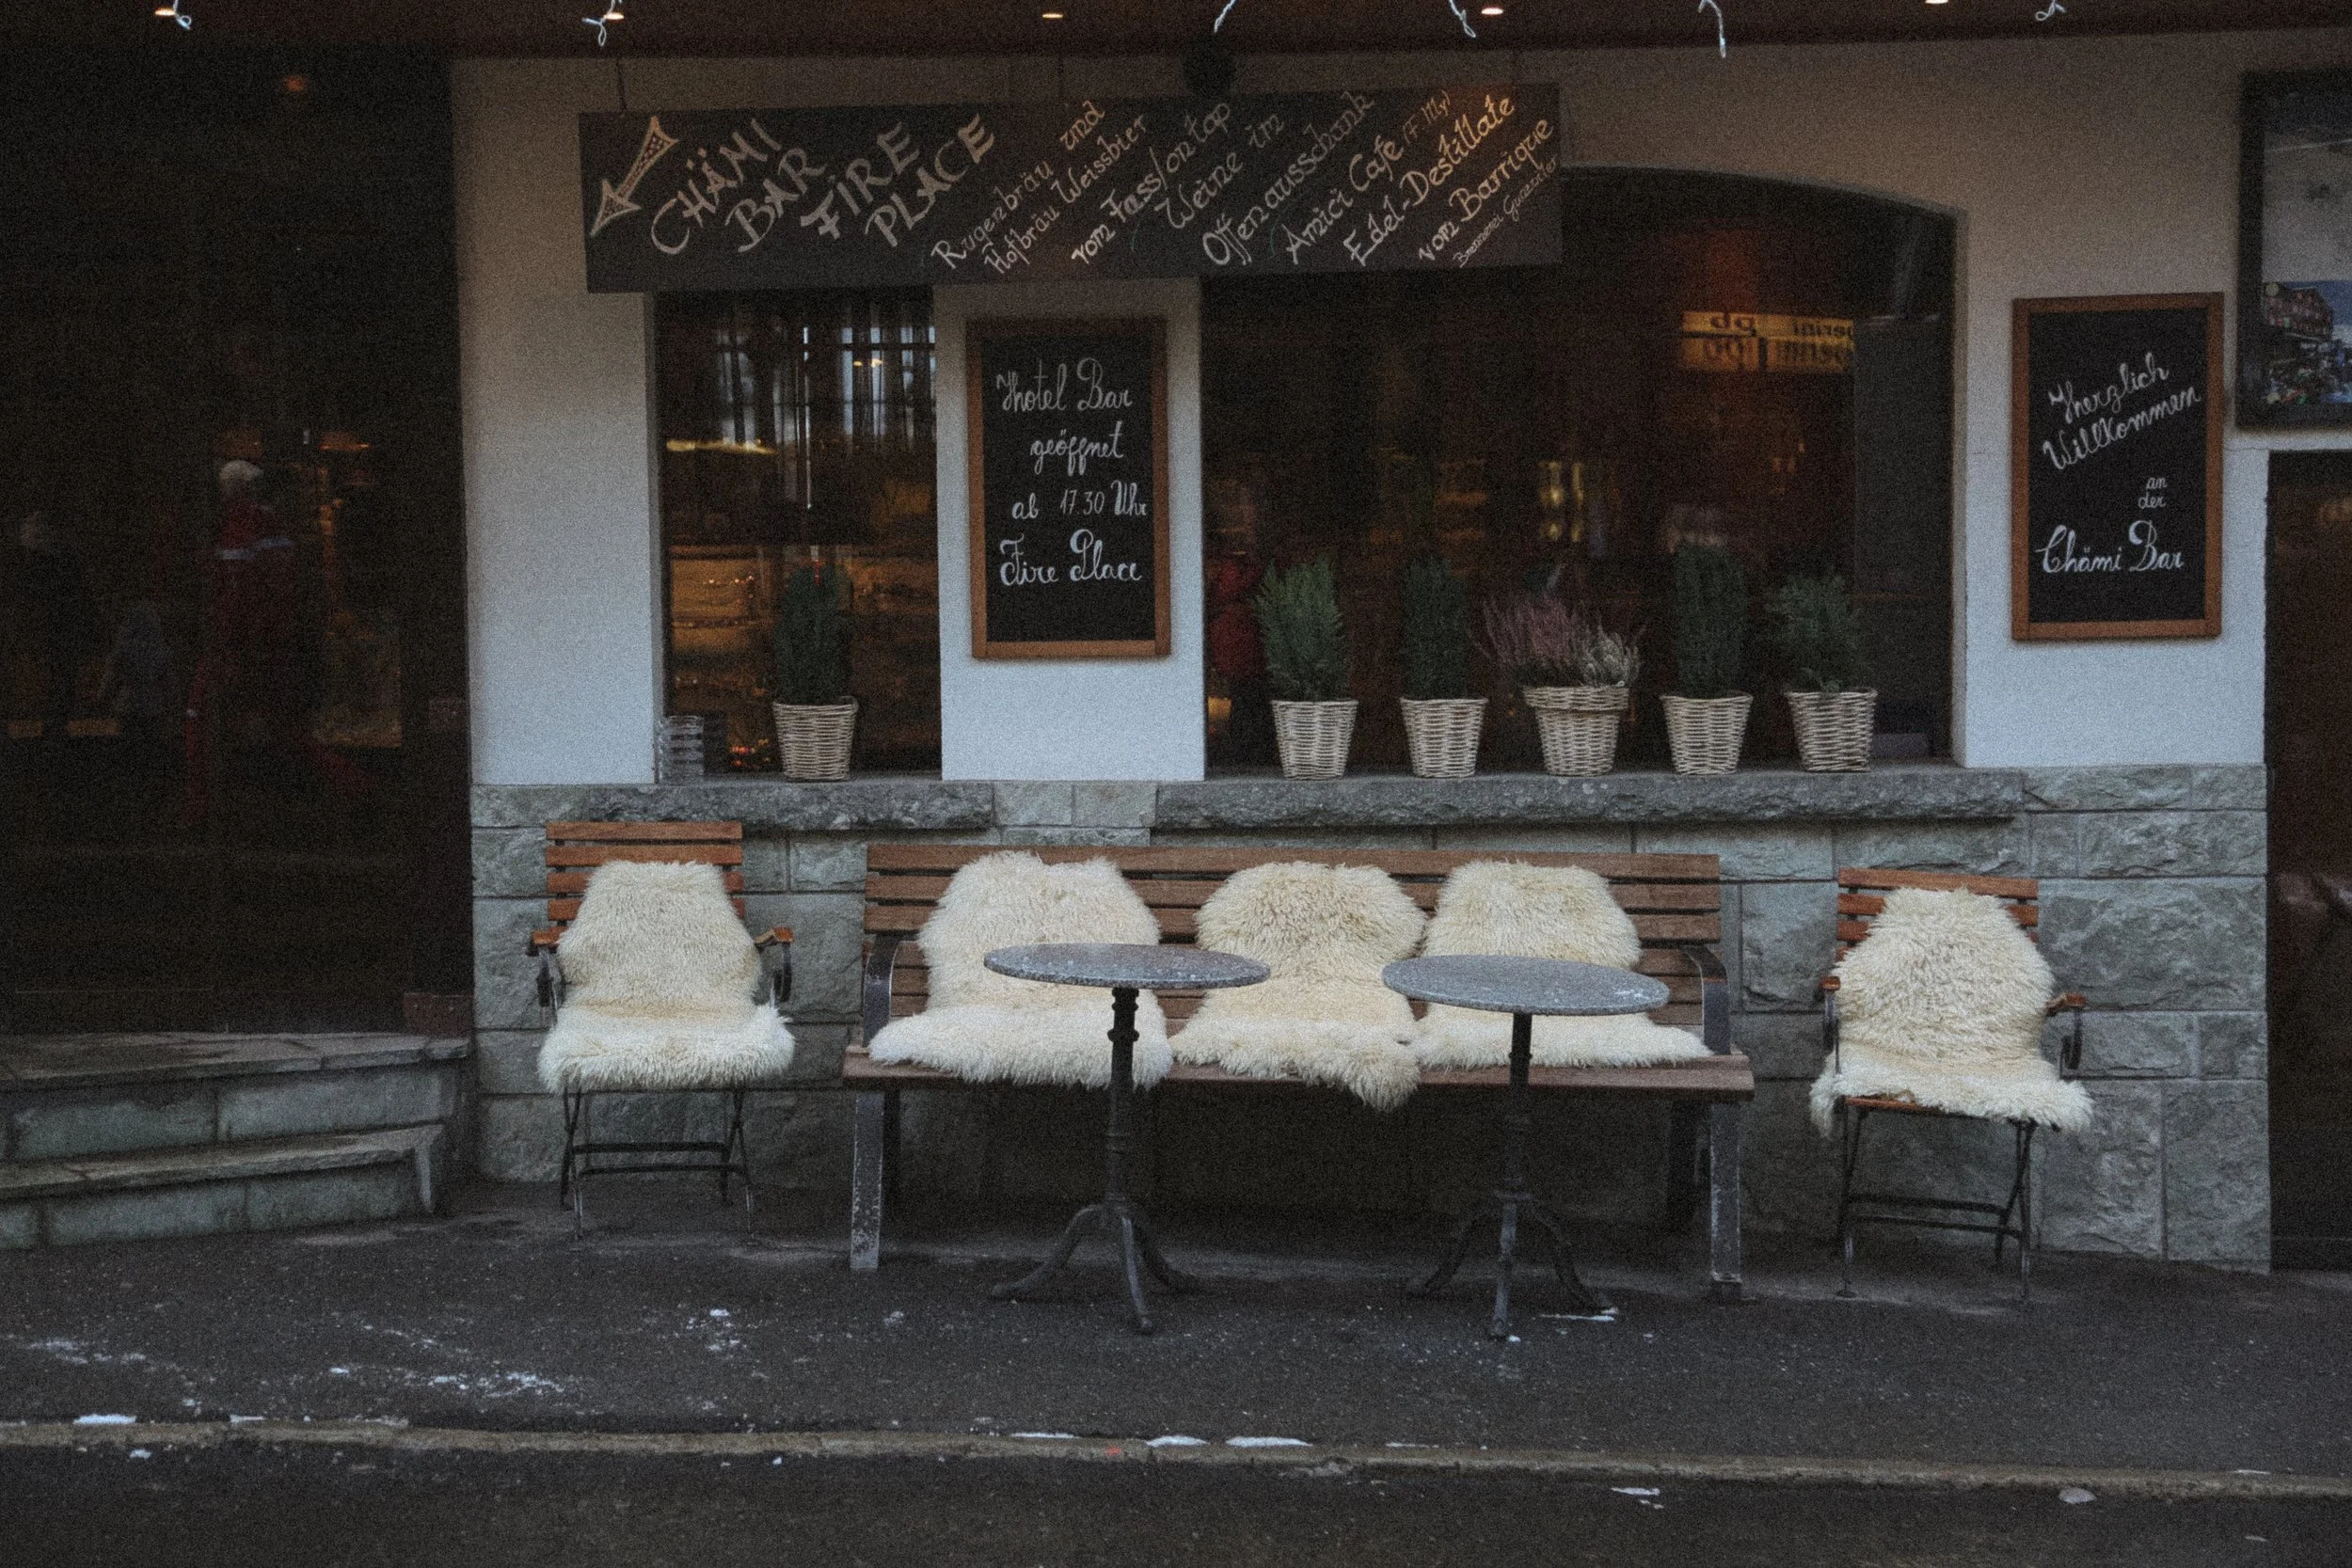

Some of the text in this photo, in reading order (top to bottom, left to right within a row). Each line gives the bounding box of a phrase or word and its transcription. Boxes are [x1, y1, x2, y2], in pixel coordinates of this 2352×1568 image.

[1184, 103, 1231, 142] tap
[651, 118, 782, 254] CHÄMI
[724, 148, 828, 252] BAR
[800, 121, 919, 239] FIRE
[865, 114, 994, 247] PLACE
[930, 100, 1105, 269] Rugenbräu und
[982, 114, 1147, 274] Hofbräu Weissbier
[1153, 151, 1244, 230] Weine
[1343, 94, 1515, 267] Edel-Destillate
[1449, 119, 1553, 223] Barrique
[1281, 188, 1353, 265] Amici
[996, 357, 1133, 412] Hotel Bar
[2048, 351, 2169, 424] Herzlich
[1030, 420, 1124, 476] geöffnet
[2042, 386, 2201, 469] Willkommen
[1011, 480, 1147, 519] ab 17.30 Uhr
[2138, 492, 2166, 509] der
[2146, 477, 2167, 490] an
[999, 529, 1142, 586] Fire Place
[2129, 520, 2185, 572] Bar
